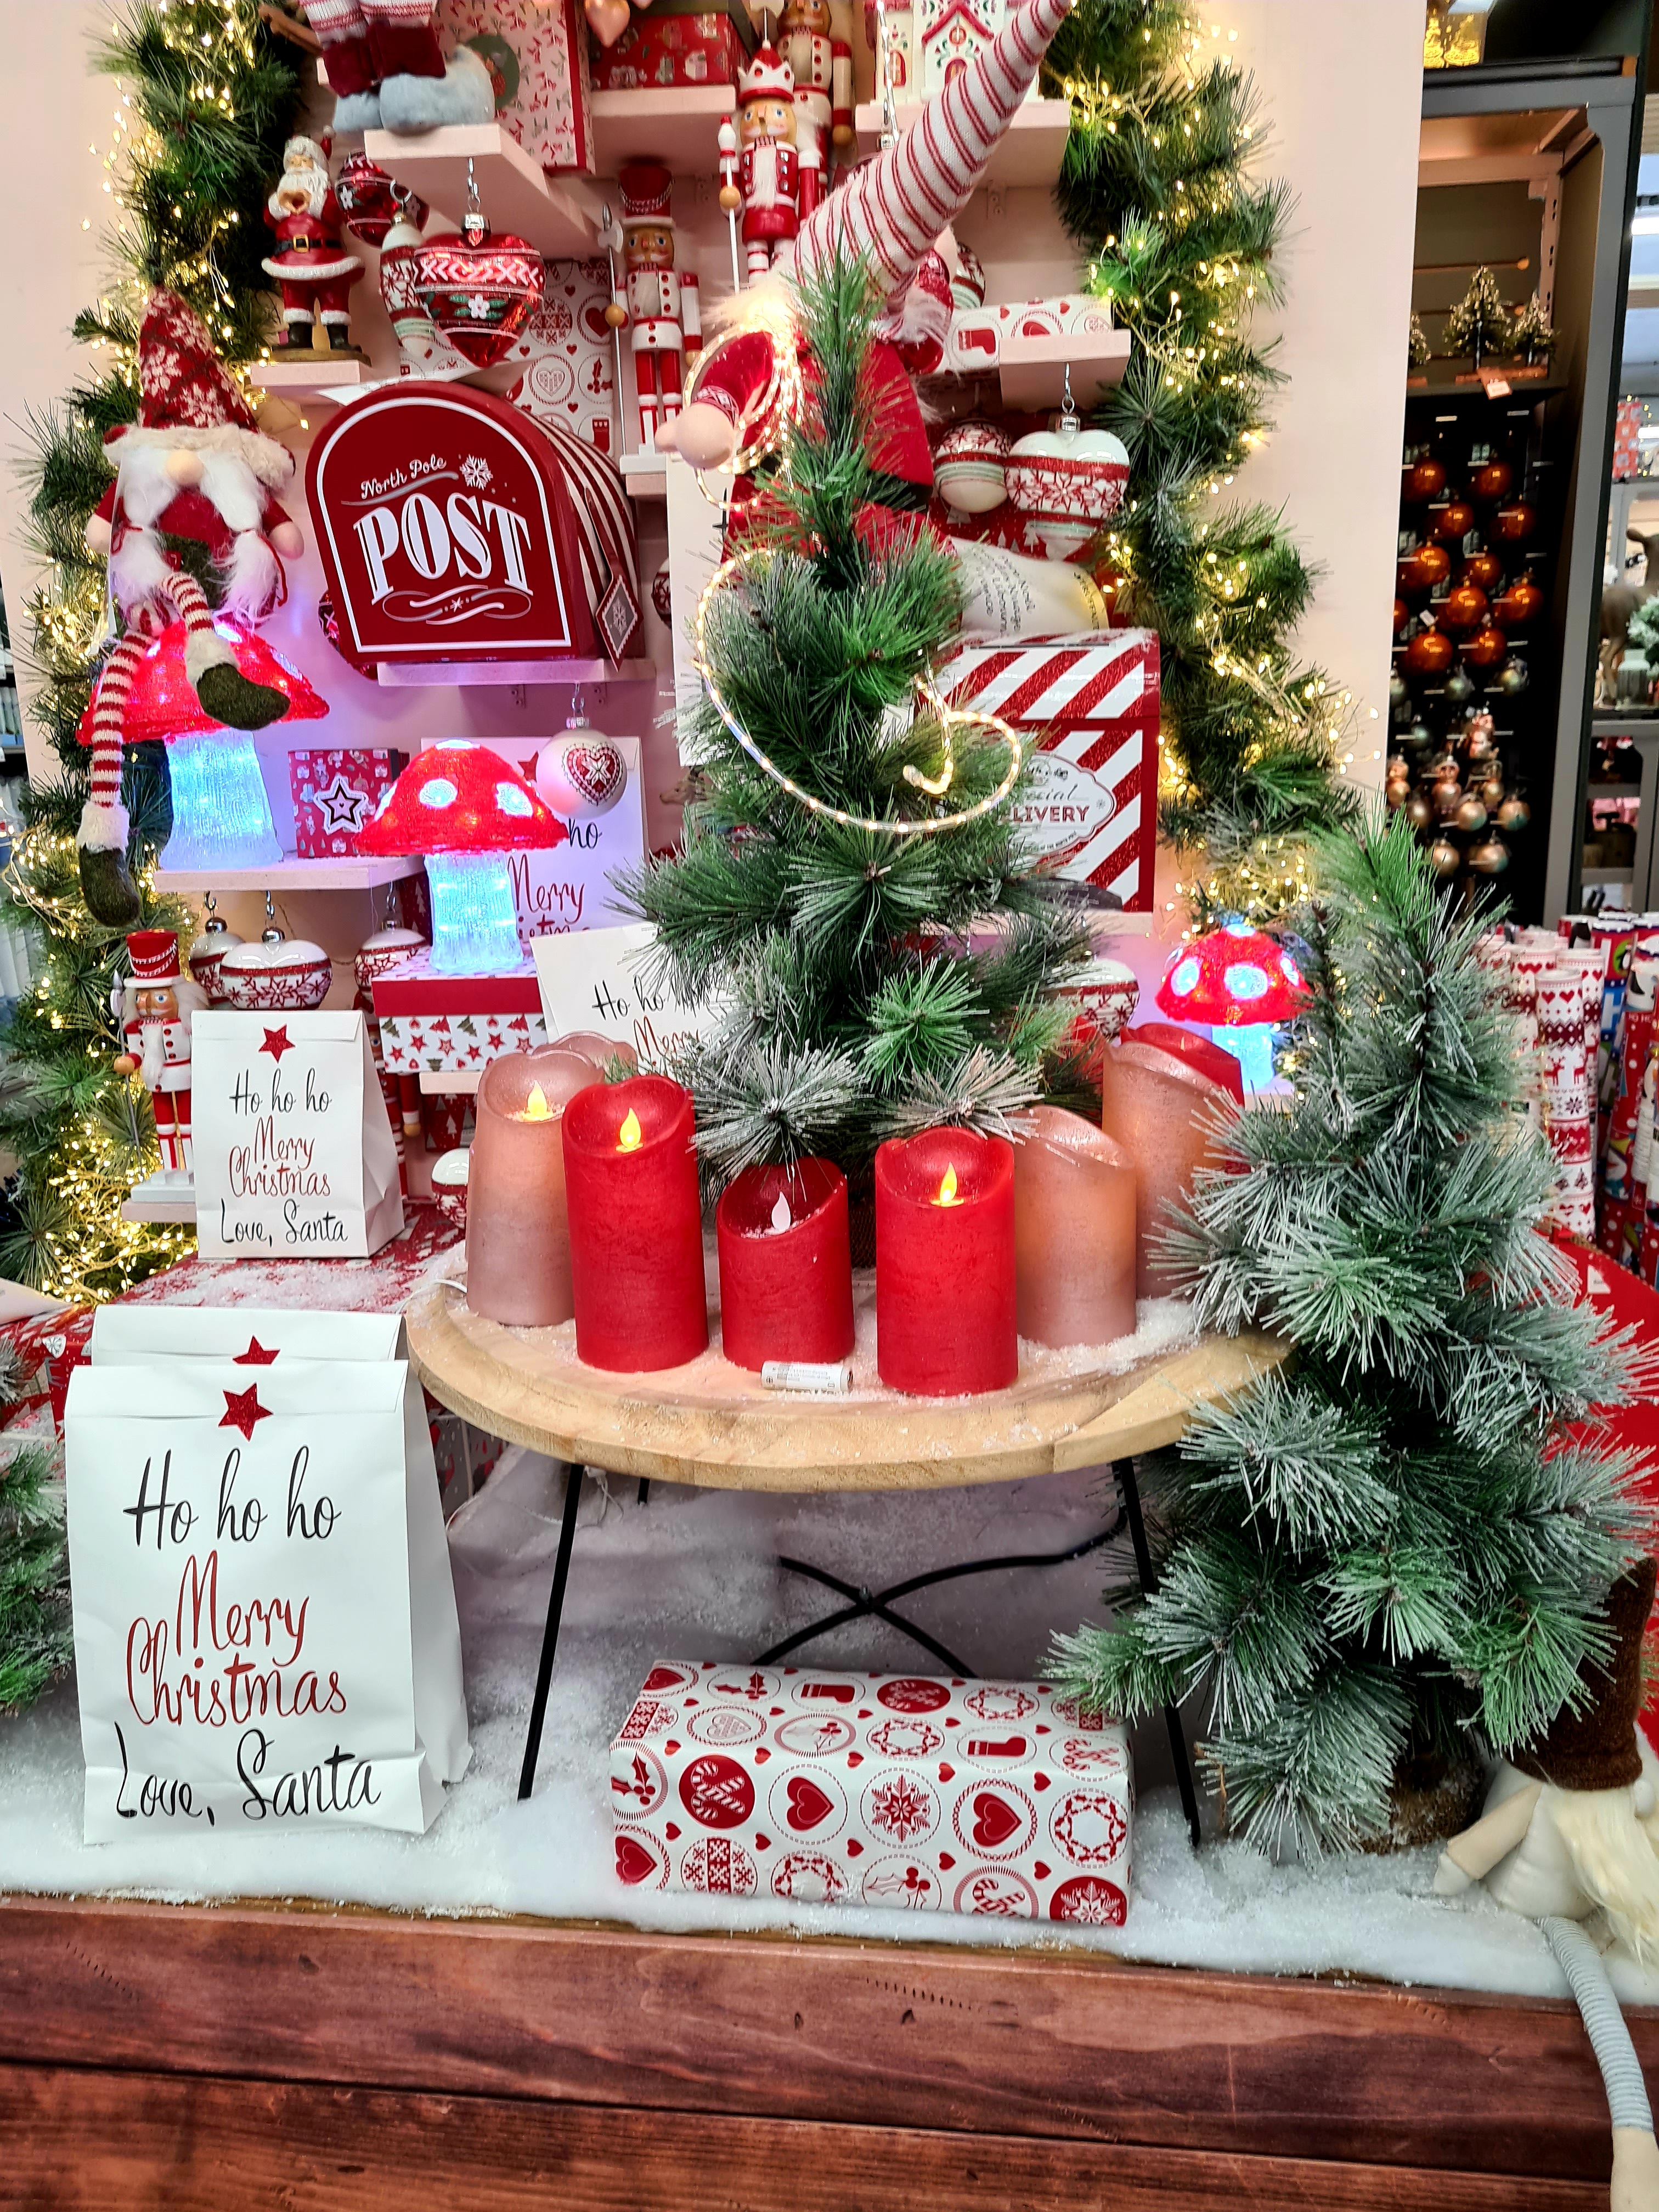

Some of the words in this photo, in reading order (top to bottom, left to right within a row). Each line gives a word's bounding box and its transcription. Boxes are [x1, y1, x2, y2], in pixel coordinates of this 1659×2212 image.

[360, 468, 408, 500] North
[409, 453, 448, 479] Pole
[353, 492, 533, 605] POST
[1013, 805, 1090, 823] LIVERY
[592, 979, 630, 1020] Ho
[633, 974, 666, 1012] ho
[229, 1068, 263, 1116] Ho
[272, 1068, 297, 1114] ho
[306, 1067, 332, 1113] ho
[254, 1115, 315, 1171] Merry
[229, 1145, 331, 1198] Christmas
[220, 1197, 273, 1248] Love,
[284, 1198, 349, 1245] Santa
[122, 1448, 199, 1551] Ho
[217, 1445, 268, 1542] ho
[286, 1444, 342, 1541] ho
[176, 1549, 310, 1667] Merry
[126, 1616, 347, 1728] Christmas
[114, 1720, 216, 1827] Love,
[236, 1727, 382, 1820] Santa
